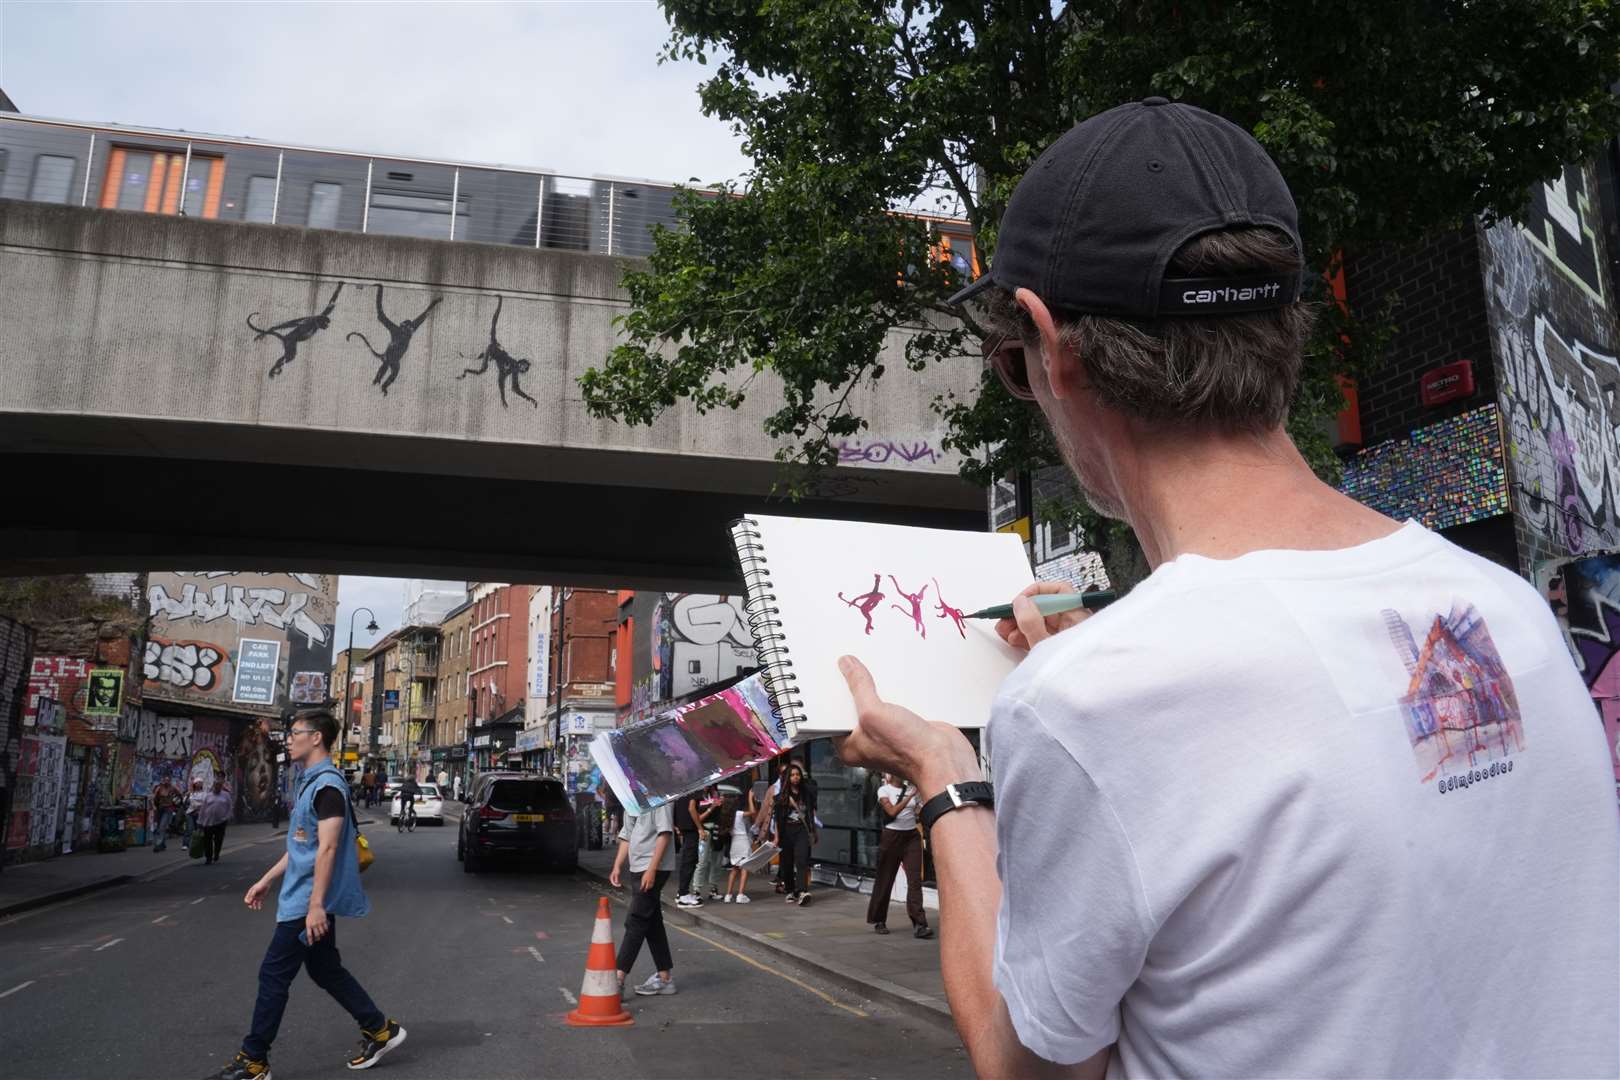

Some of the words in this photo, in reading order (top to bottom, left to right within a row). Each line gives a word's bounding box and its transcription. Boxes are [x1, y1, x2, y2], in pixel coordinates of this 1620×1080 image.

[1183, 282, 1280, 304] carhartt
[1426, 375, 1459, 390] METRO
[252, 643, 268, 651] CAR
[240, 661, 256, 669] 2ND
[256, 662, 275, 670] LEFT
